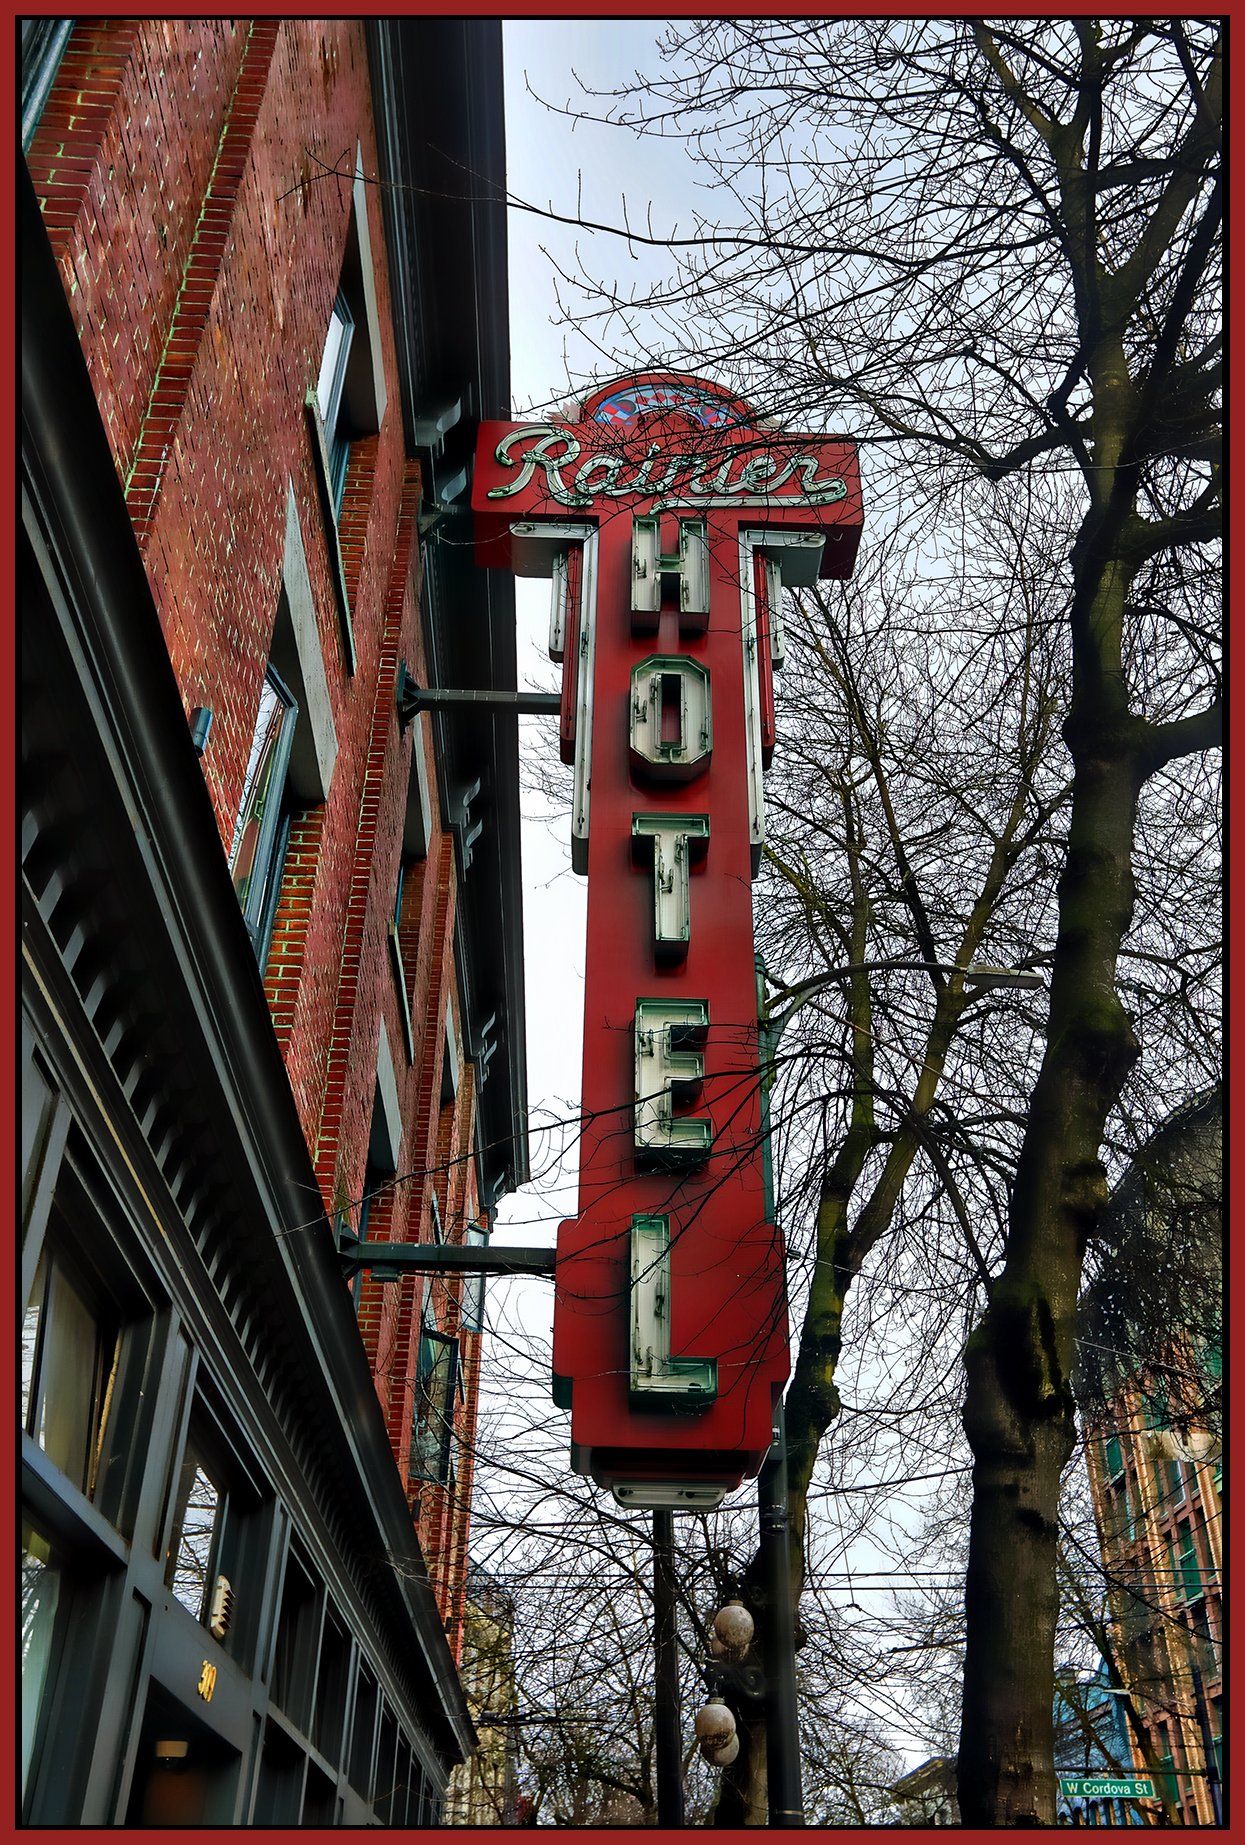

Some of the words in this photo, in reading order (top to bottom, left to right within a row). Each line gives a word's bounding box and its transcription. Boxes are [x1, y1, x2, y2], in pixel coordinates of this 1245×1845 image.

[487, 424, 849, 515] Rainier
[629, 515, 719, 1398] HOTEL
[1066, 1782, 1079, 1794] W
[1082, 1782, 1131, 1795] Cordova
[1135, 1783, 1149, 1795] St
